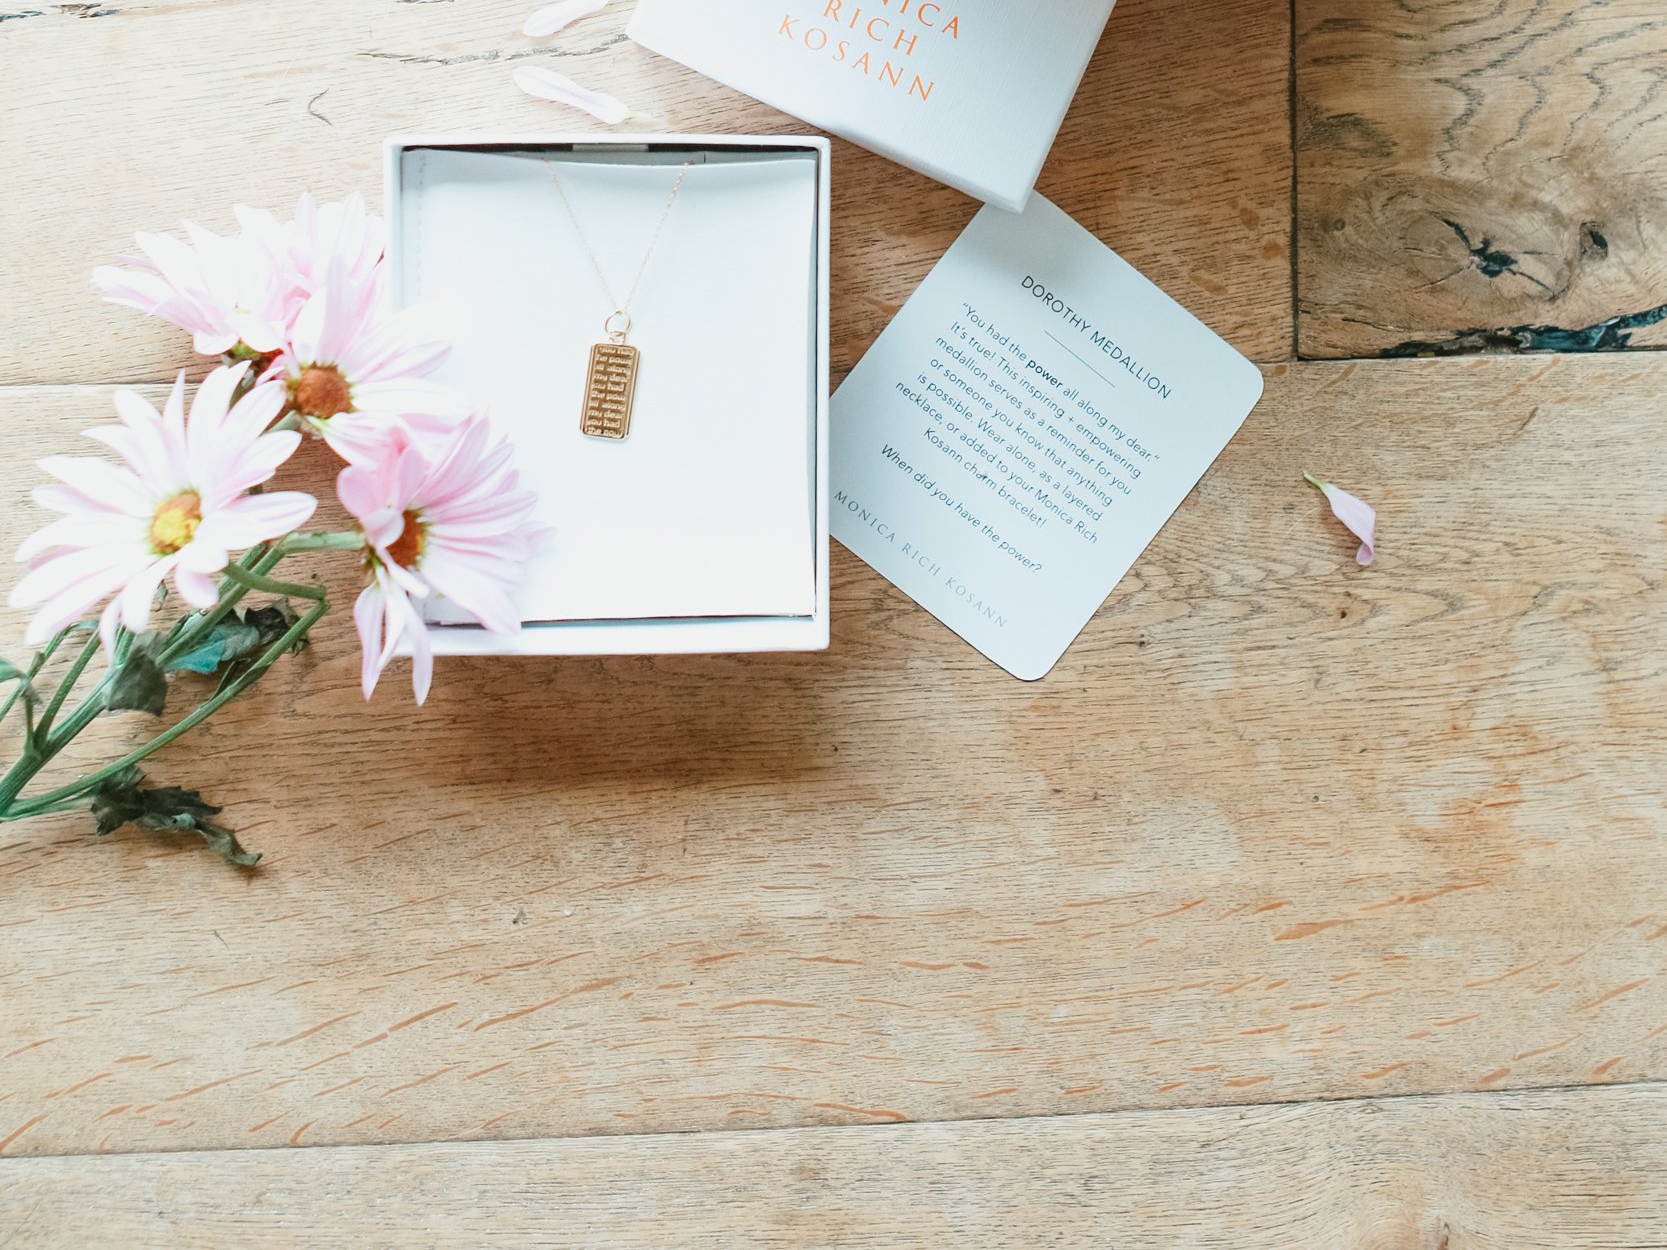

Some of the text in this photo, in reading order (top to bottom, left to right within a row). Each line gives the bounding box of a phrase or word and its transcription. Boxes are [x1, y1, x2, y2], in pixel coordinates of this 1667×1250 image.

[778, 13, 936, 102] KOSANN
[950, 320, 968, 340] It’s
[968, 336, 997, 362] true!
[996, 356, 1019, 381] This
[1018, 375, 1066, 420] inspiring
[1075, 423, 1142, 480] empowering
[985, 323, 1011, 346] had
[1008, 342, 1028, 362] the
[1024, 359, 1064, 389] power
[1062, 388, 1080, 401] all
[1076, 399, 1109, 428] along
[1107, 423, 1127, 441] my
[1020, 275, 1172, 400] DOROTHY MEDALLION
[895, 382, 1098, 544] necklace, or added to your Monica Rich
[916, 371, 1104, 522] is possible. Wear alone, as a layered
[923, 426, 1048, 529] Kosann charm bracelet!
[930, 358, 1113, 508] or someone you know that anything
[935, 337, 1132, 496] medallion serves as a reminder for you
[833, 490, 1007, 628] MONICA RICH KOSANN
[881, 443, 1043, 574] When did you have the power?
